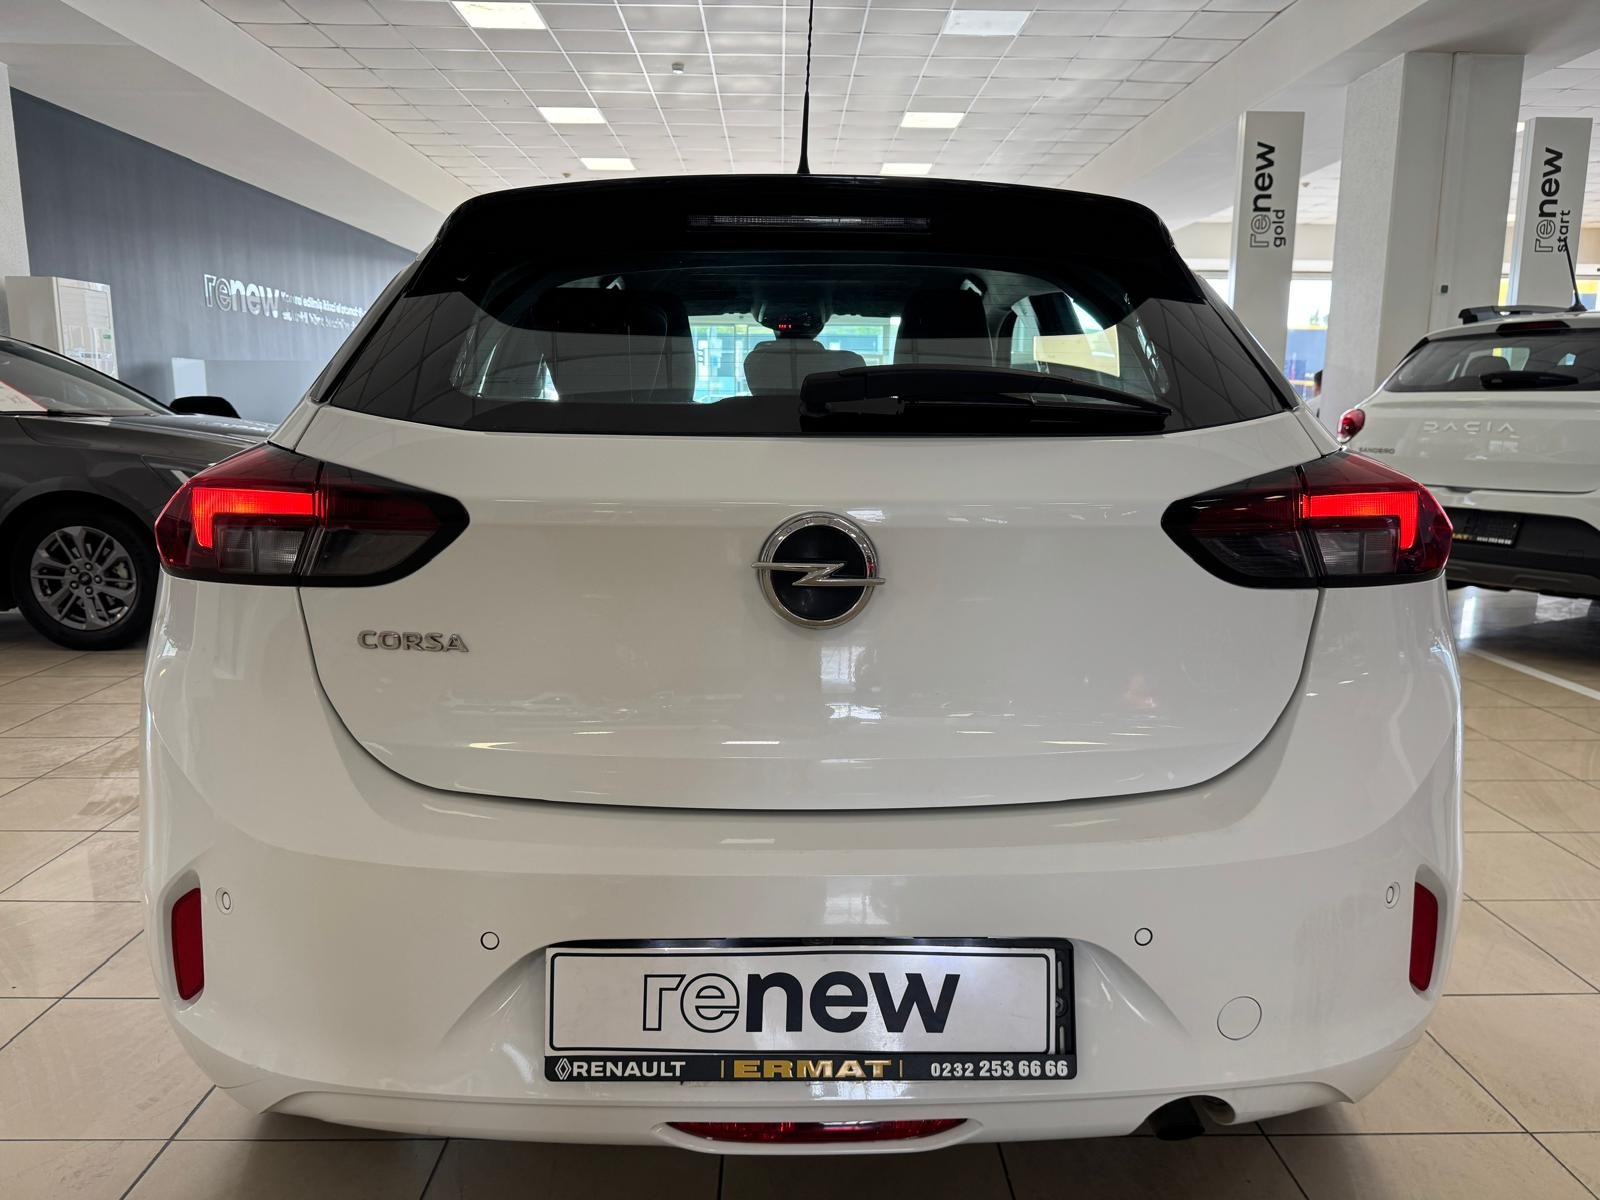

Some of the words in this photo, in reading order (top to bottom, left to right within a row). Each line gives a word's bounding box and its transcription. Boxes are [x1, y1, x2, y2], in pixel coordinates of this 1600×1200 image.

[1249, 141, 1276, 248] renew
[1534, 146, 1564, 253] renew
[1272, 208, 1286, 248] gold
[1557, 210, 1571, 253] start
[203, 273, 280, 318] renew
[1423, 421, 1516, 433] DACIA
[357, 629, 470, 653] CORSA
[642, 969, 961, 1034] renew
[572, 1061, 686, 1077] RENAULT
[733, 1059, 892, 1079] ERMAT
[930, 1062, 975, 1078] 0232
[979, 1060, 1014, 1078] 253
[1018, 1060, 1042, 1077] 66
[1045, 1060, 1069, 1077] 66
